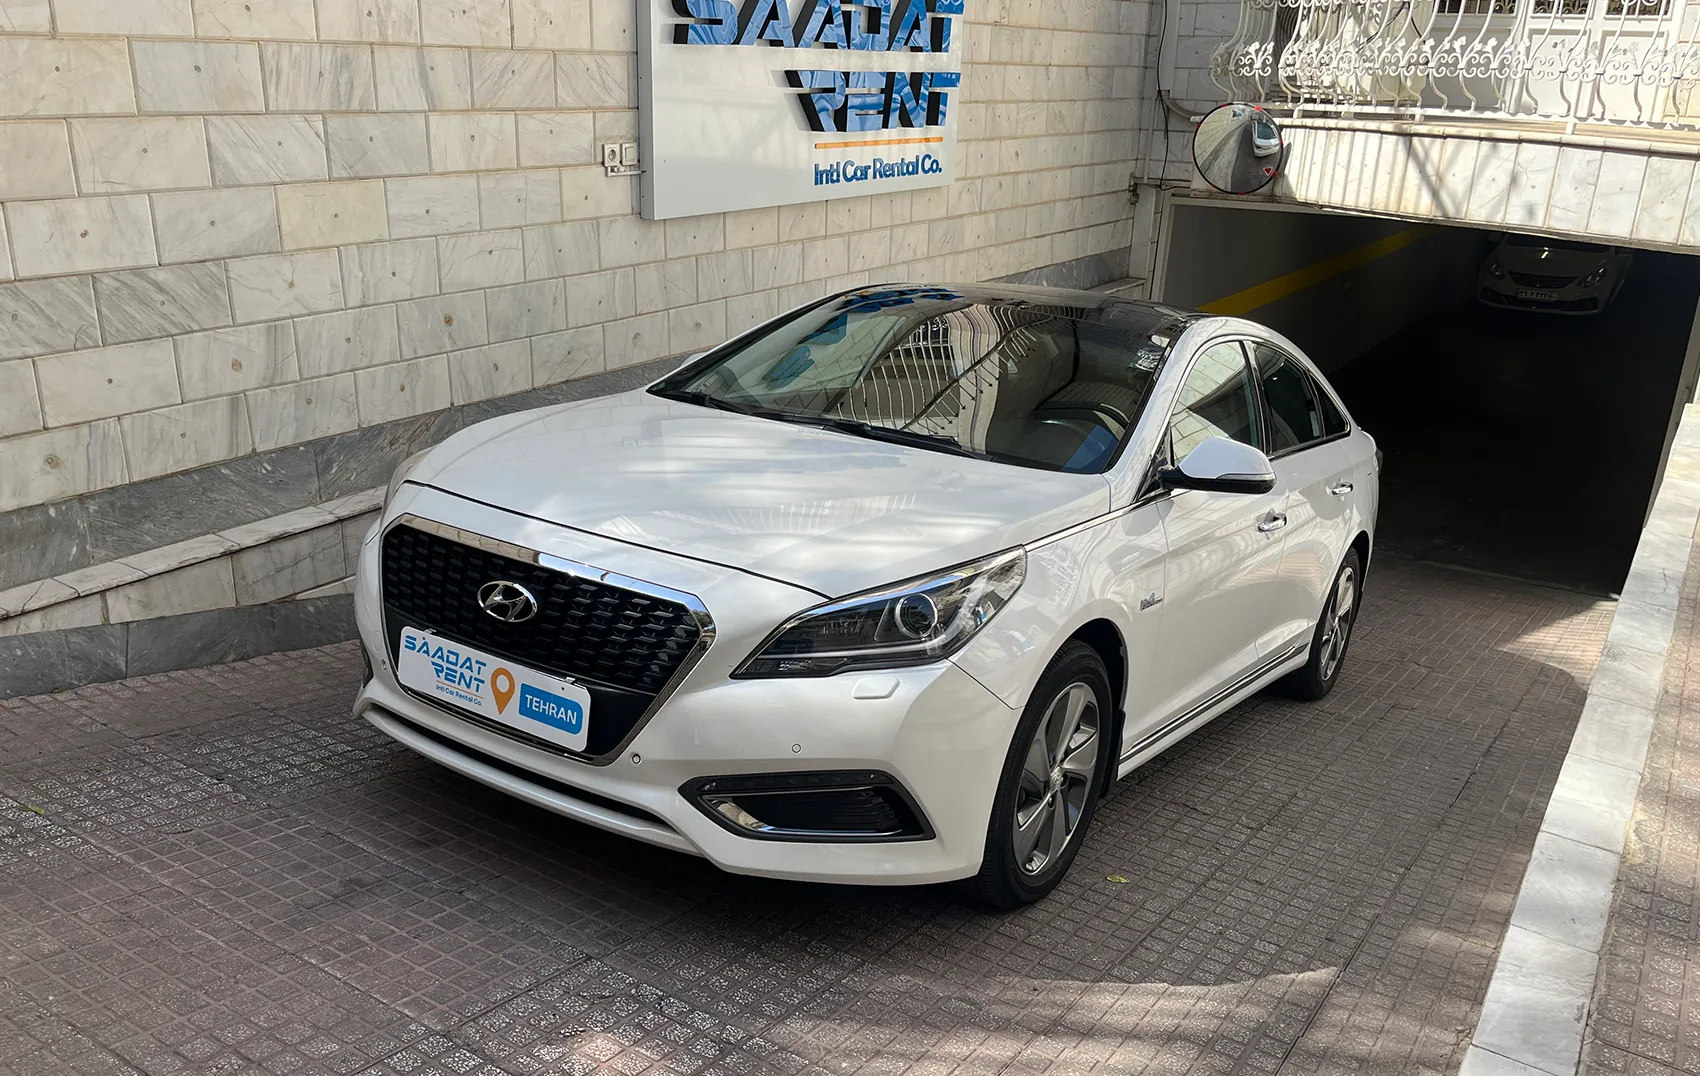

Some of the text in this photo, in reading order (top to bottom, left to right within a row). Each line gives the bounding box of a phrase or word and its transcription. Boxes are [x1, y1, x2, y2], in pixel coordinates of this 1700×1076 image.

[674, 0, 965, 53] SAADAT
[785, 70, 961, 132] RENT
[842, 159, 871, 182] Car
[872, 154, 920, 180] Rental
[920, 153, 943, 174] Co.
[404, 635, 488, 676] SAADAT
[430, 660, 486, 693] RENT
[445, 687, 455, 696] Car
[455, 691, 473, 703] Rental
[525, 694, 578, 725] TEHRAN
